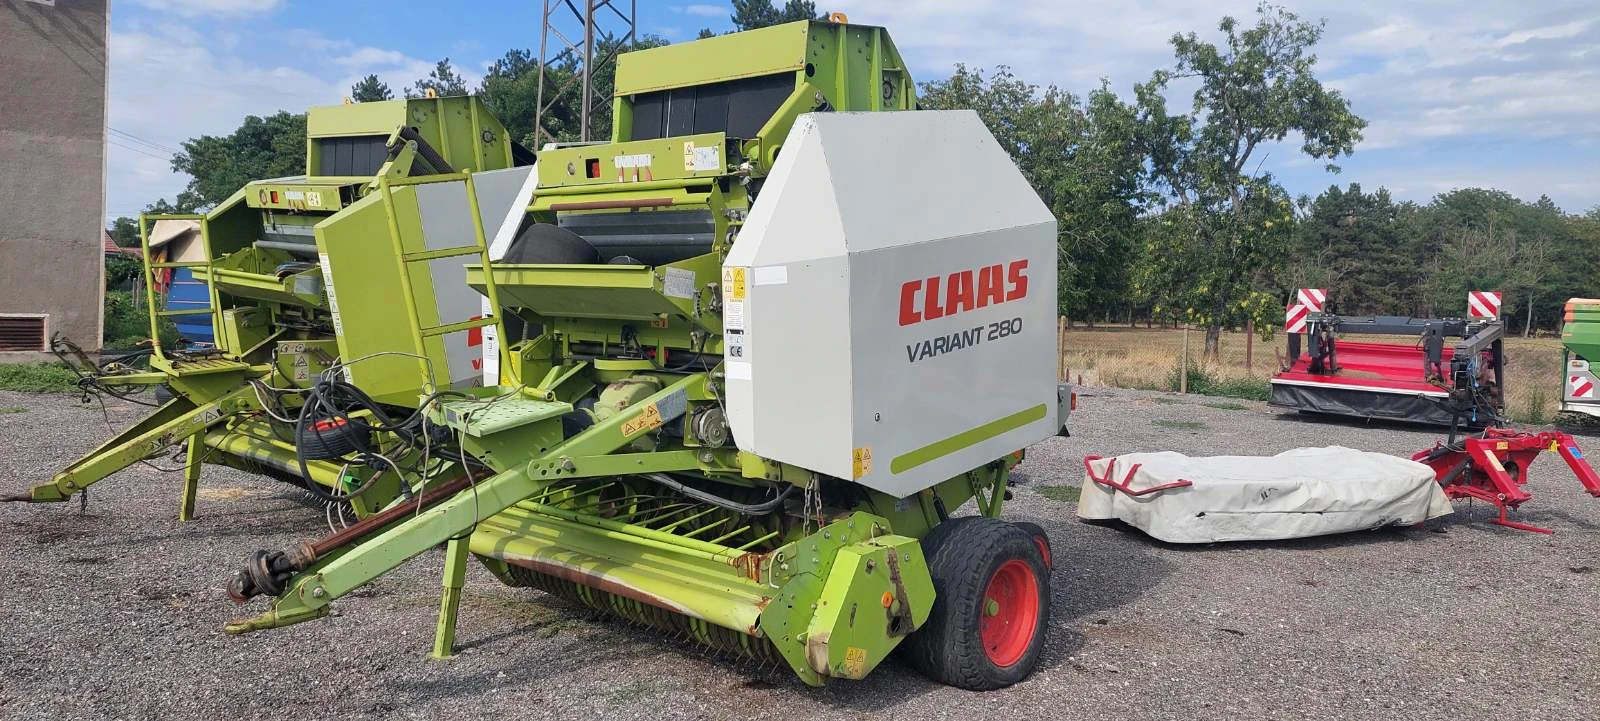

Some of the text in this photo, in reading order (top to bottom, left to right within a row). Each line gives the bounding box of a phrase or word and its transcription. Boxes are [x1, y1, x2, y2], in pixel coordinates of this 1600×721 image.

[899, 259, 1028, 326] CLAAS
[906, 317, 1023, 363] VARIANT 280
